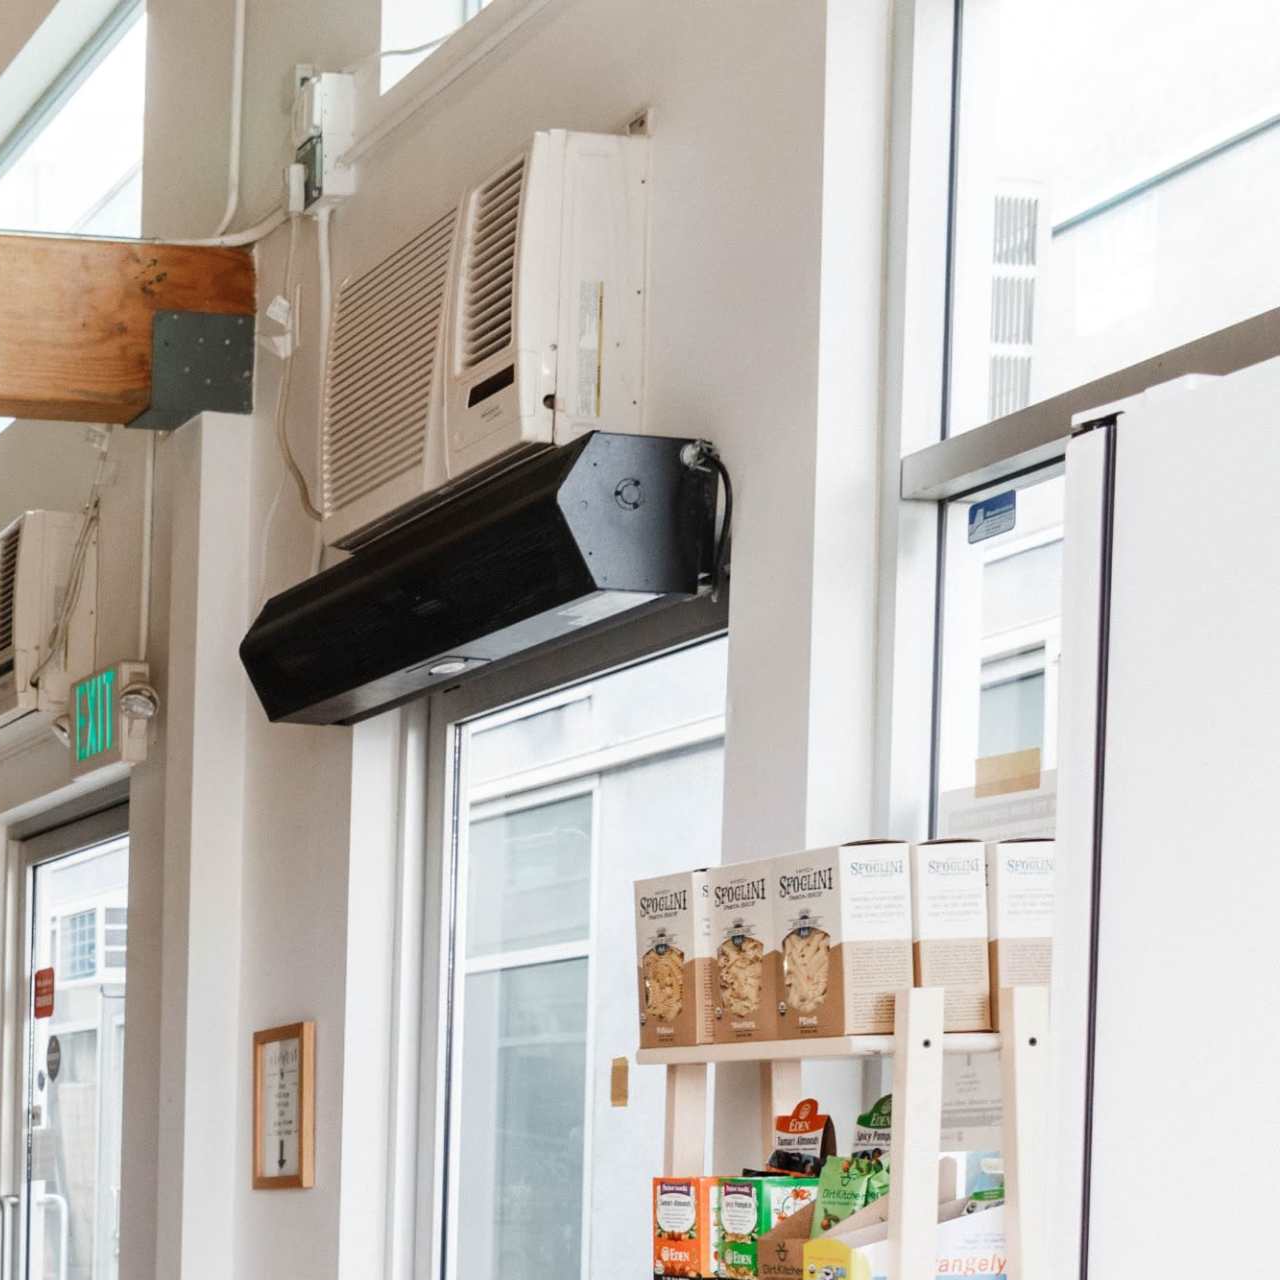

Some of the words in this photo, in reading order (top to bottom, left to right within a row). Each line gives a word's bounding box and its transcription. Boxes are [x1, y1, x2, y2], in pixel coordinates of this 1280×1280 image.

[75, 668, 116, 765] EXIT
[714, 878, 766, 907] SFOGLINI
[779, 867, 834, 898] SFOGLINI
[640, 890, 688, 918] SFOGLINI
[788, 1119, 811, 1132] EDEN
[874, 1131, 891, 1141] Pump
[670, 1248, 690, 1261] EDEN
[733, 1251, 753, 1264] EDEN
